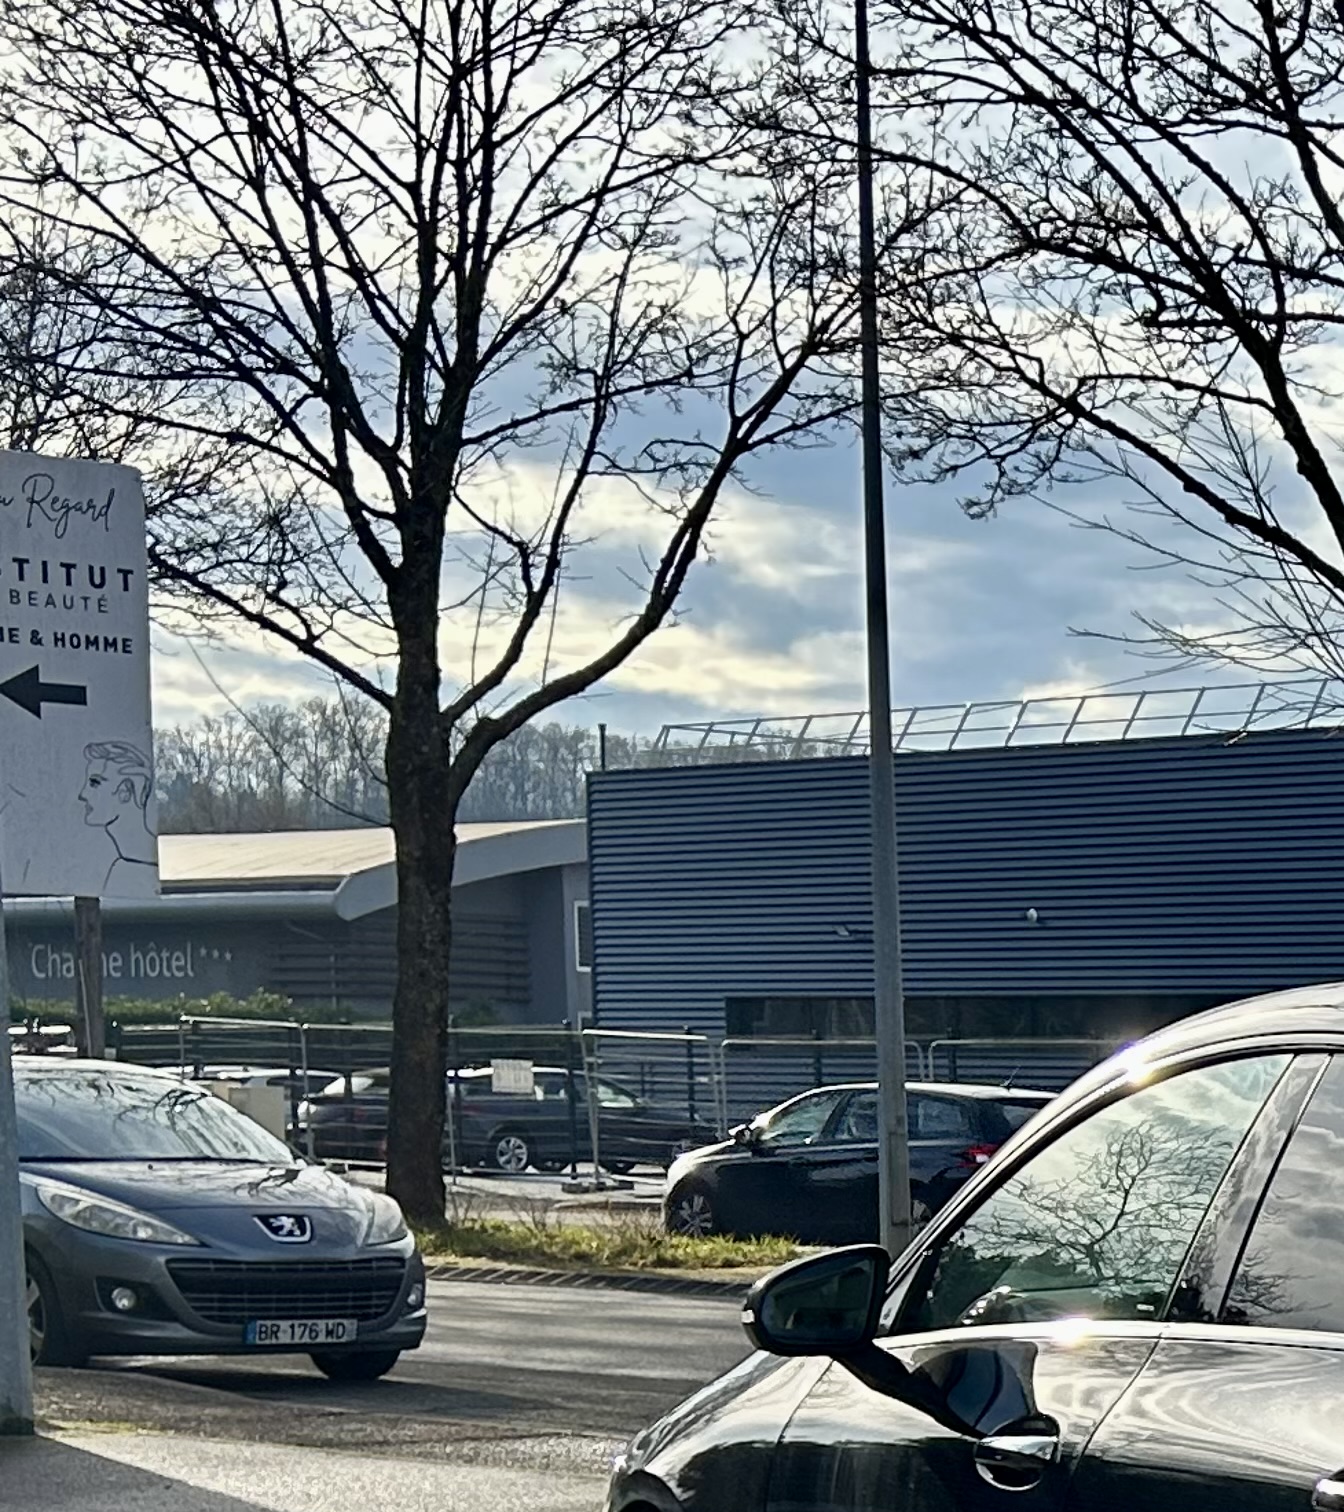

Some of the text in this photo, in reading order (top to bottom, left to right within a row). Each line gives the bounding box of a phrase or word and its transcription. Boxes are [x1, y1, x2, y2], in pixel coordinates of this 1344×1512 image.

[22, 473, 115, 539] Regard
[0, 557, 134, 592] TITUT
[9, 588, 109, 614] BEAUTÉ
[30, 629, 44, 646] &
[53, 631, 133, 654] HOMME
[31, 941, 194, 978] Chae hôtel
